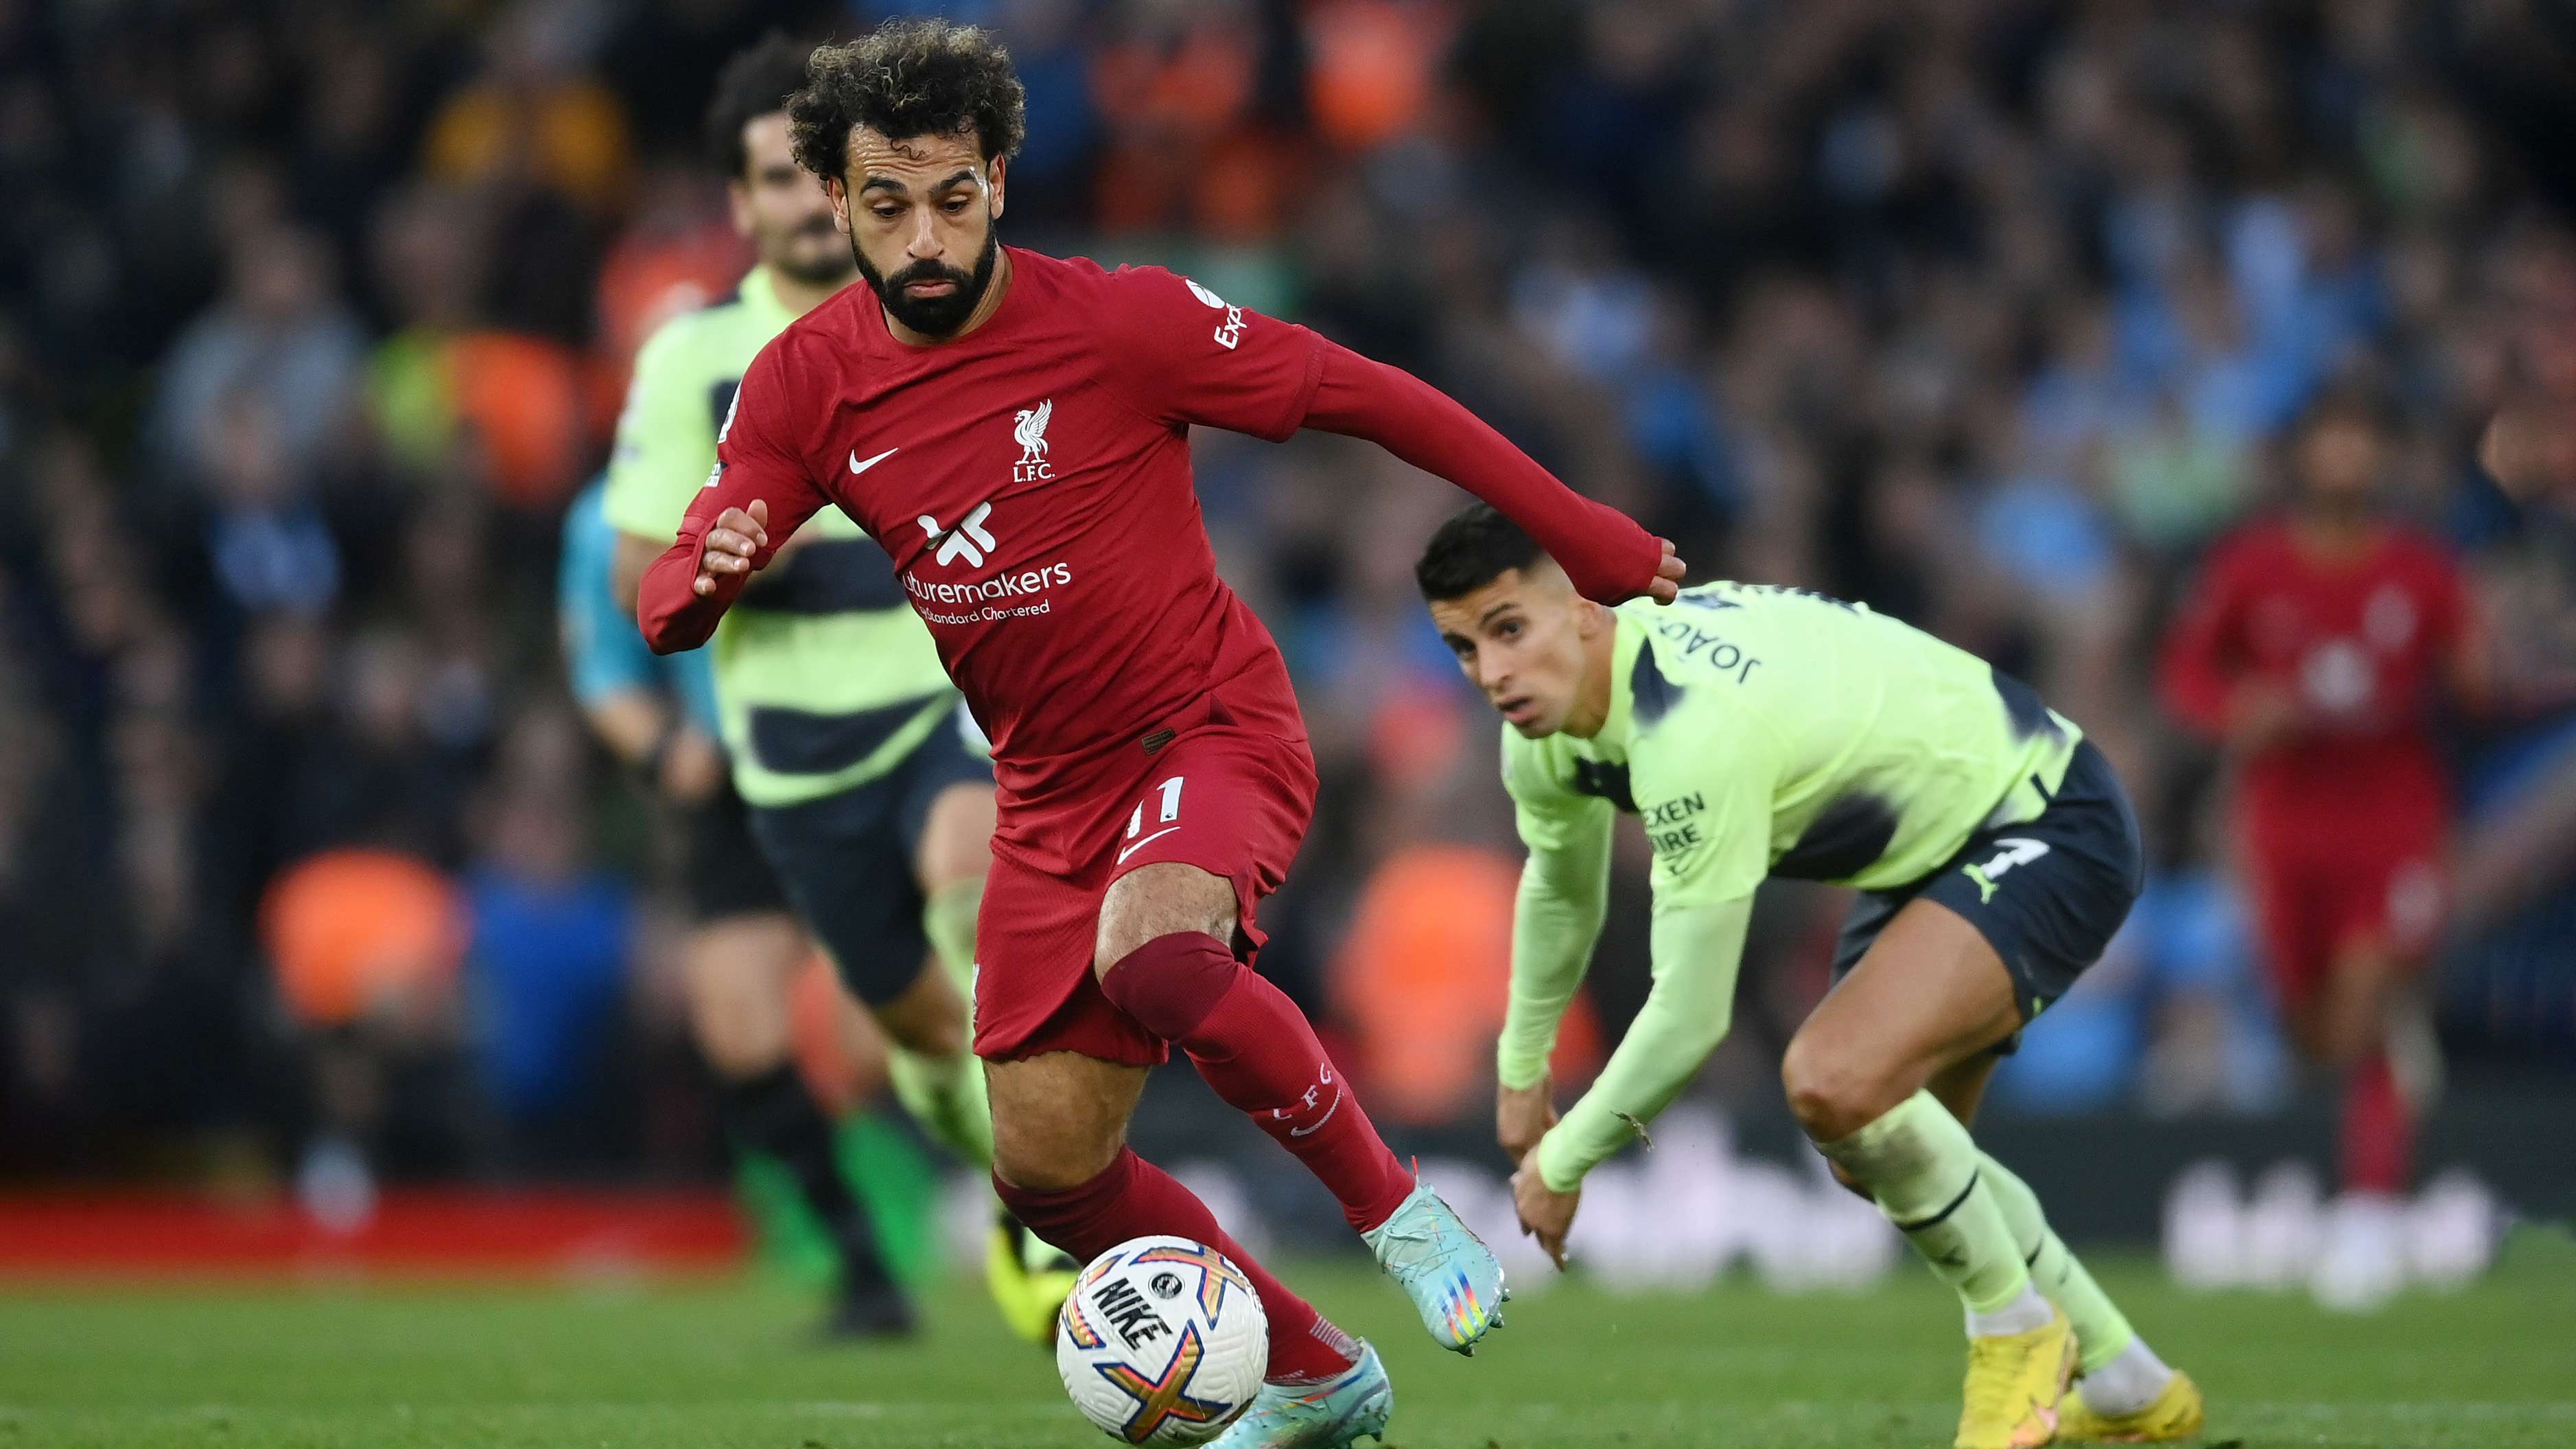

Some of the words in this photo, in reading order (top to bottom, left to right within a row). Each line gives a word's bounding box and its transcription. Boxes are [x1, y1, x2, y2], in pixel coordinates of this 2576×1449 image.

[1213, 303, 1248, 349] Exp
[1013, 463, 1055, 483] L.F.C.
[902, 562, 1072, 603] uturemakers
[926, 607, 980, 625] Standard
[981, 599, 1051, 621] Chartered
[1980, 837, 2051, 879] 7
[1091, 1277, 1173, 1352] NIKE
